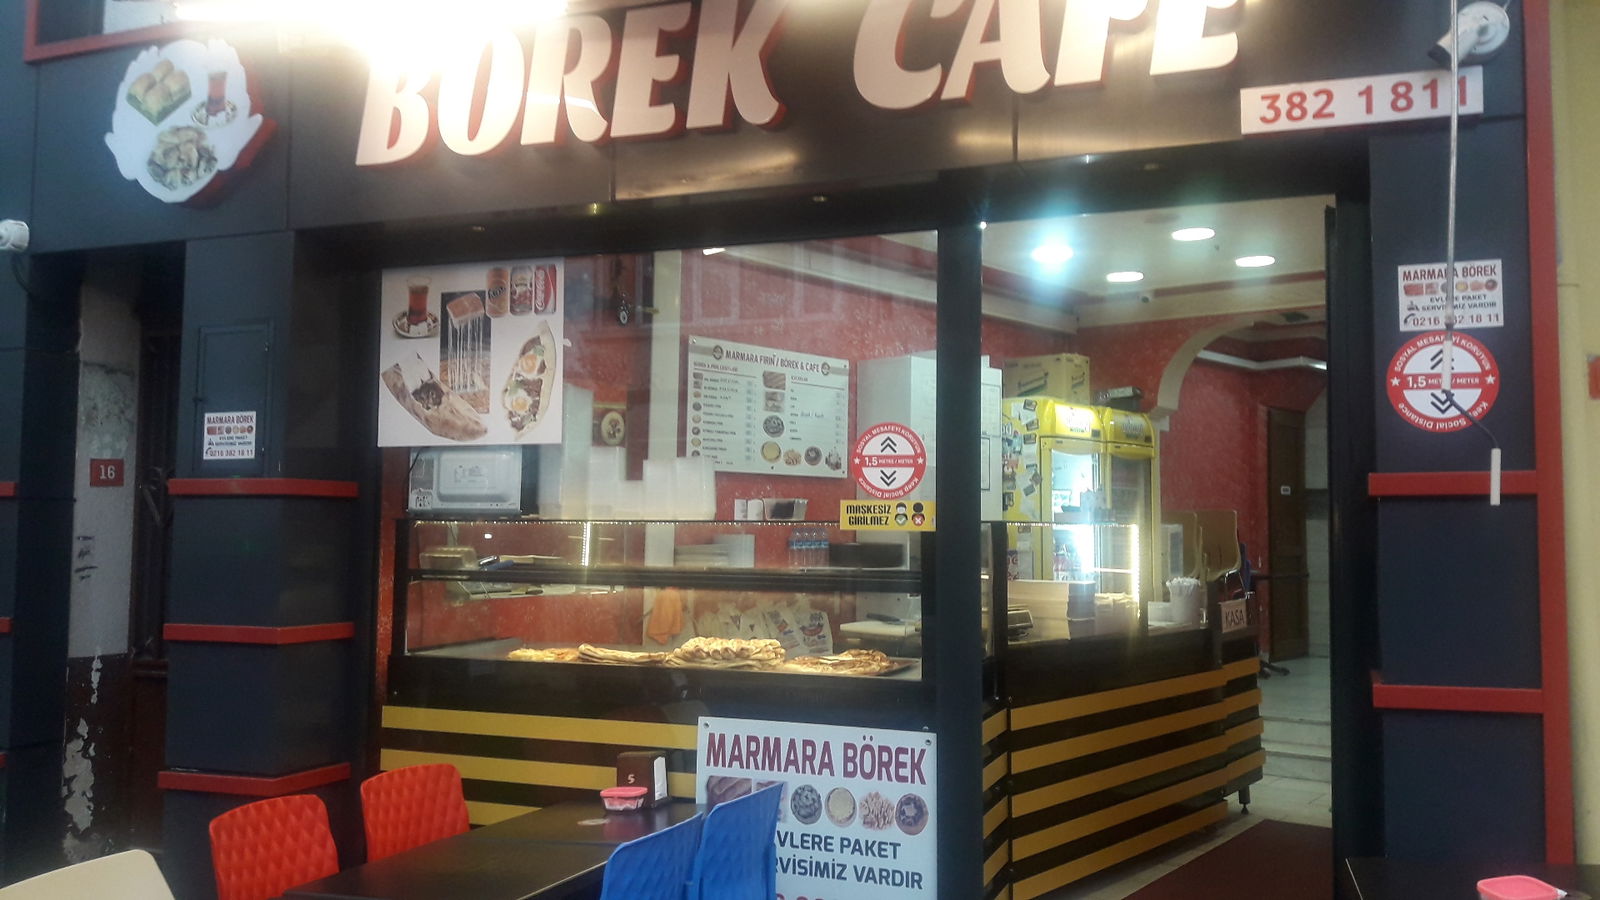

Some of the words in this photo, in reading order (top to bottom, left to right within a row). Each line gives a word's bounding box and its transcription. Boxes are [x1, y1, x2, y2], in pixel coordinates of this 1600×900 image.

[1259, 88, 1335, 124] 382
[1413, 316, 1440, 326] 0216
[1488, 313, 1499, 322] 11
[725, 350, 759, 364] MARMARA
[1394, 346, 1417, 372] SOSYAL
[99, 465, 116, 480] 16
[846, 504, 891, 515] MASKESİZ
[848, 515, 890, 526] GİRİLMEZ
[1225, 609, 1245, 626] KASA
[706, 732, 835, 777] MARMARA
[842, 734, 927, 785] BÖREK
[776, 830, 835, 852] VLERE
[839, 837, 901, 860] PAKET
[853, 864, 923, 890] VARDIR
